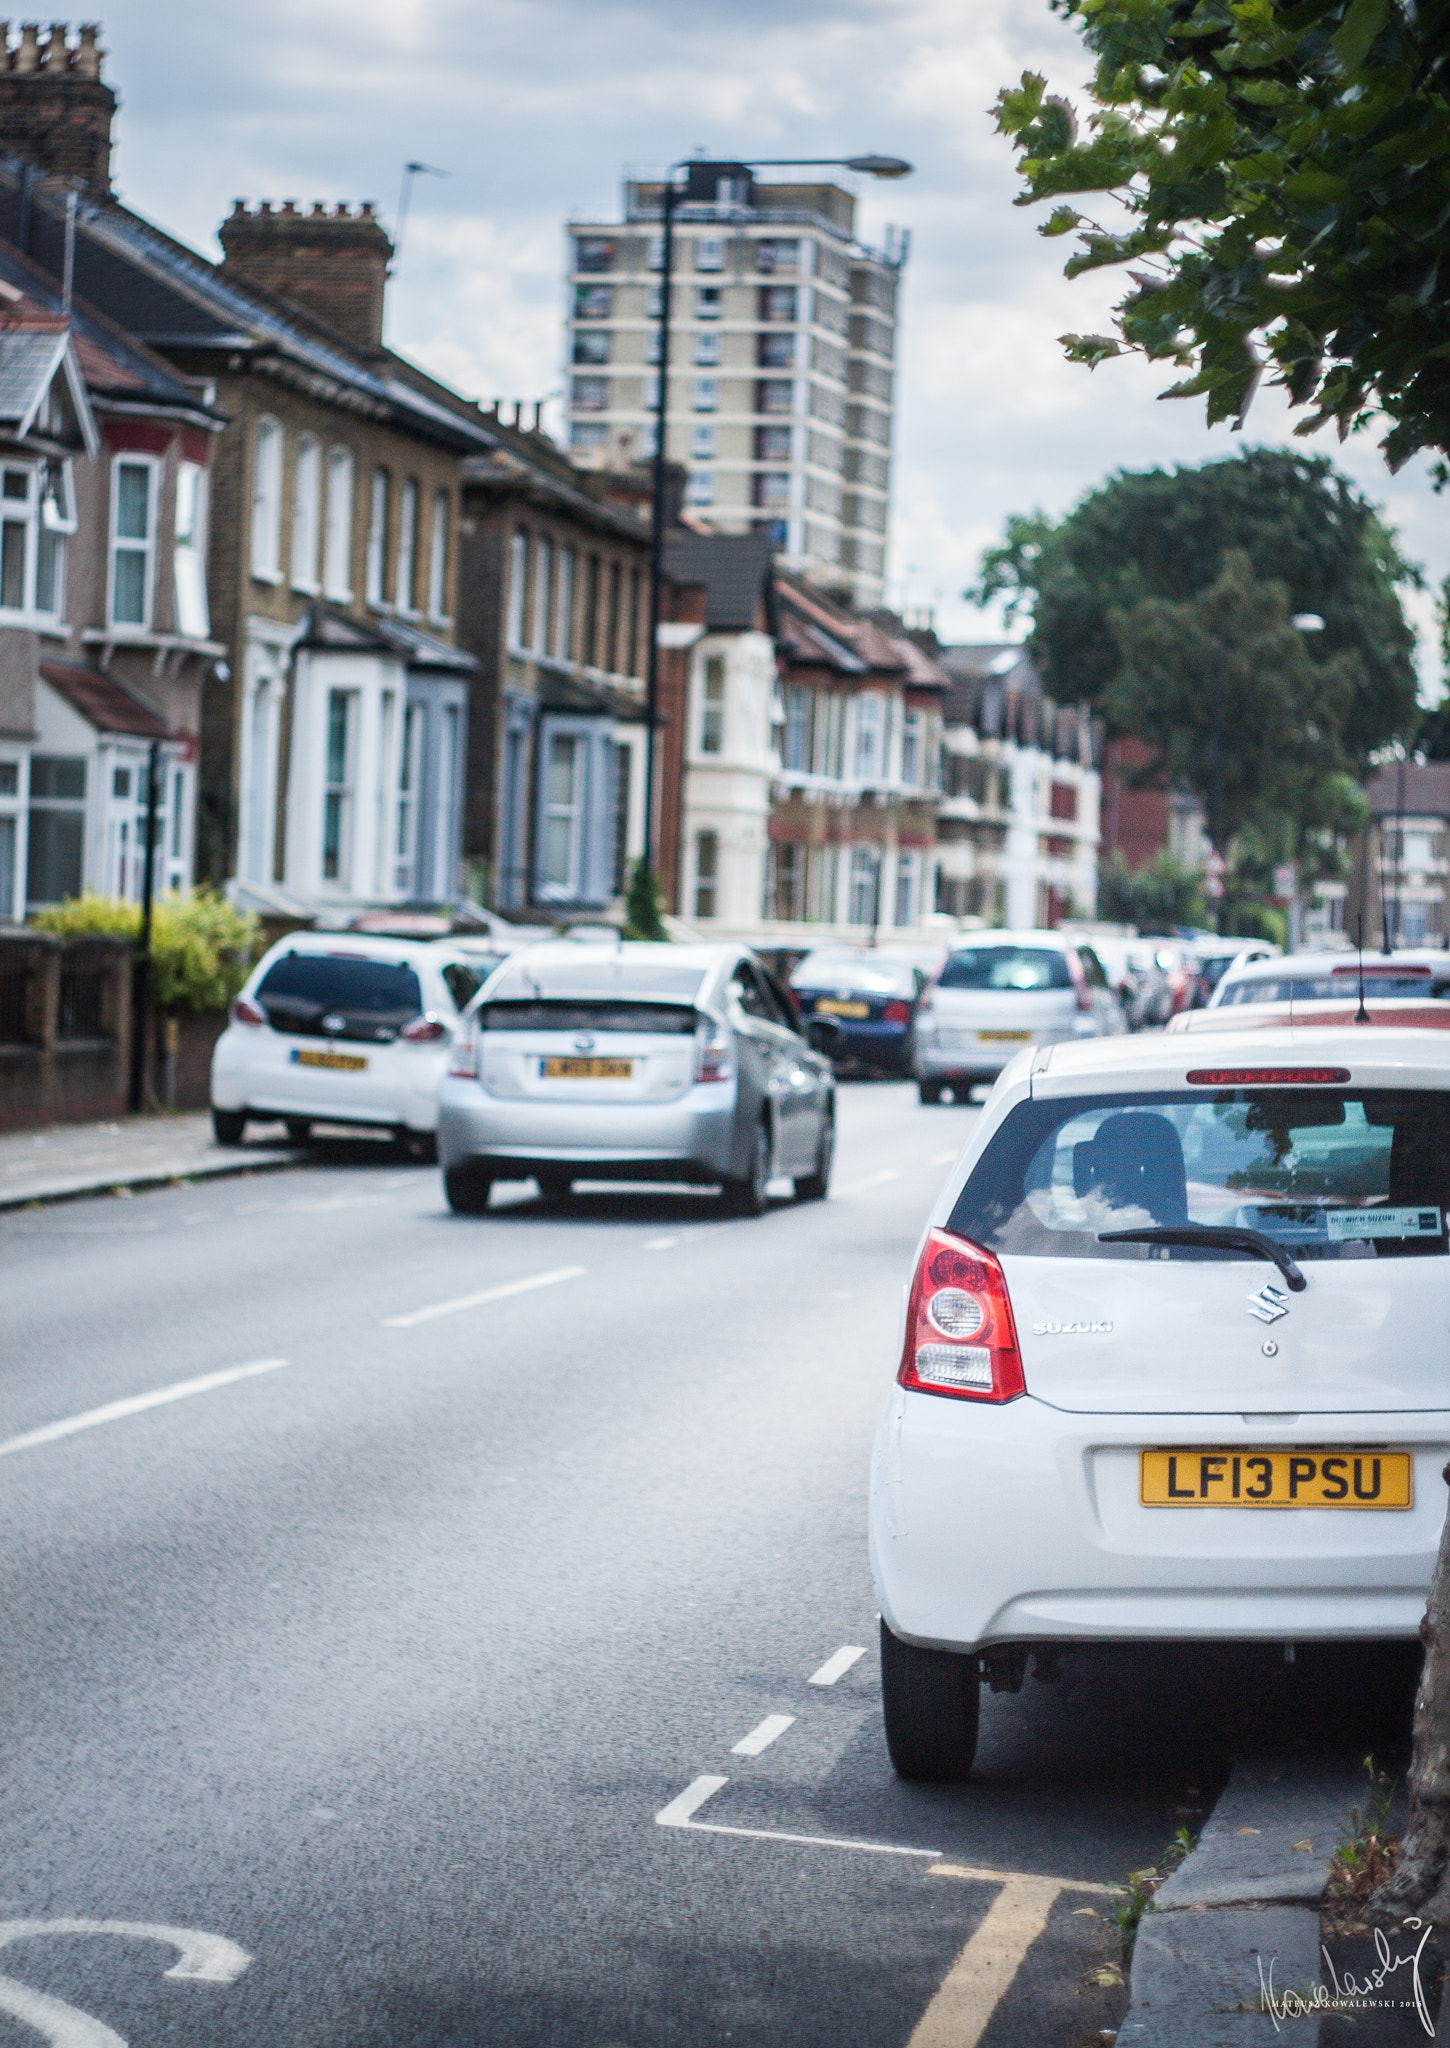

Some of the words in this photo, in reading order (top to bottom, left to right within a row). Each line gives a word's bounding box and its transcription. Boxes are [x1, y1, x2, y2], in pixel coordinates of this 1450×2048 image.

[1367, 1213, 1395, 1222] SUZUKI
[1032, 1319, 1114, 1336] SUZUKI
[1168, 1455, 1273, 1499] LF13
[1289, 1457, 1382, 1500] PSU
